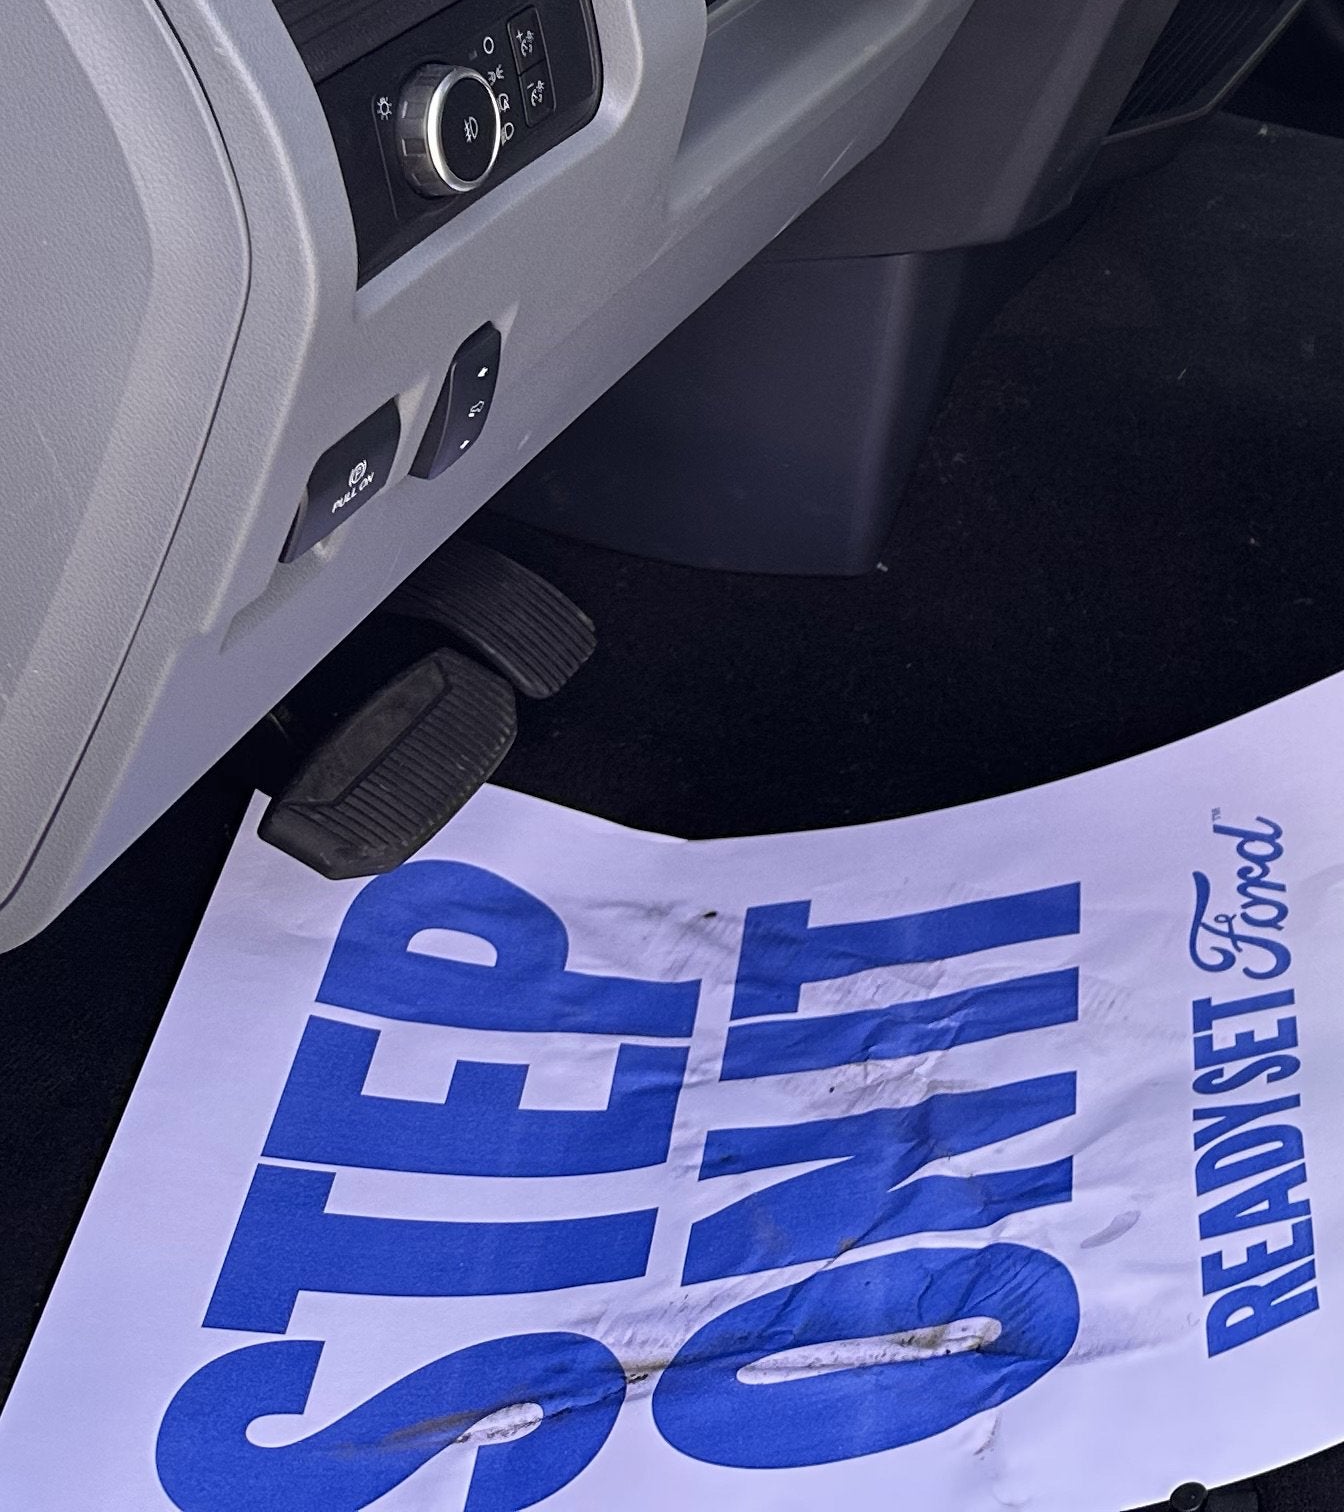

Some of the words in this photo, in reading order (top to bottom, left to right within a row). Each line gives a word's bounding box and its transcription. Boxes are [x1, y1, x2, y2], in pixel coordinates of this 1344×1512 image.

[331, 486, 358, 514] PULL
[358, 471, 375, 492] ON
[1189, 816, 1292, 980] Ford
[1191, 987, 1302, 1096] SET
[154, 858, 703, 1512] STEP
[652, 1069, 1081, 1471] ON
[1191, 1092, 1321, 1359] READY
